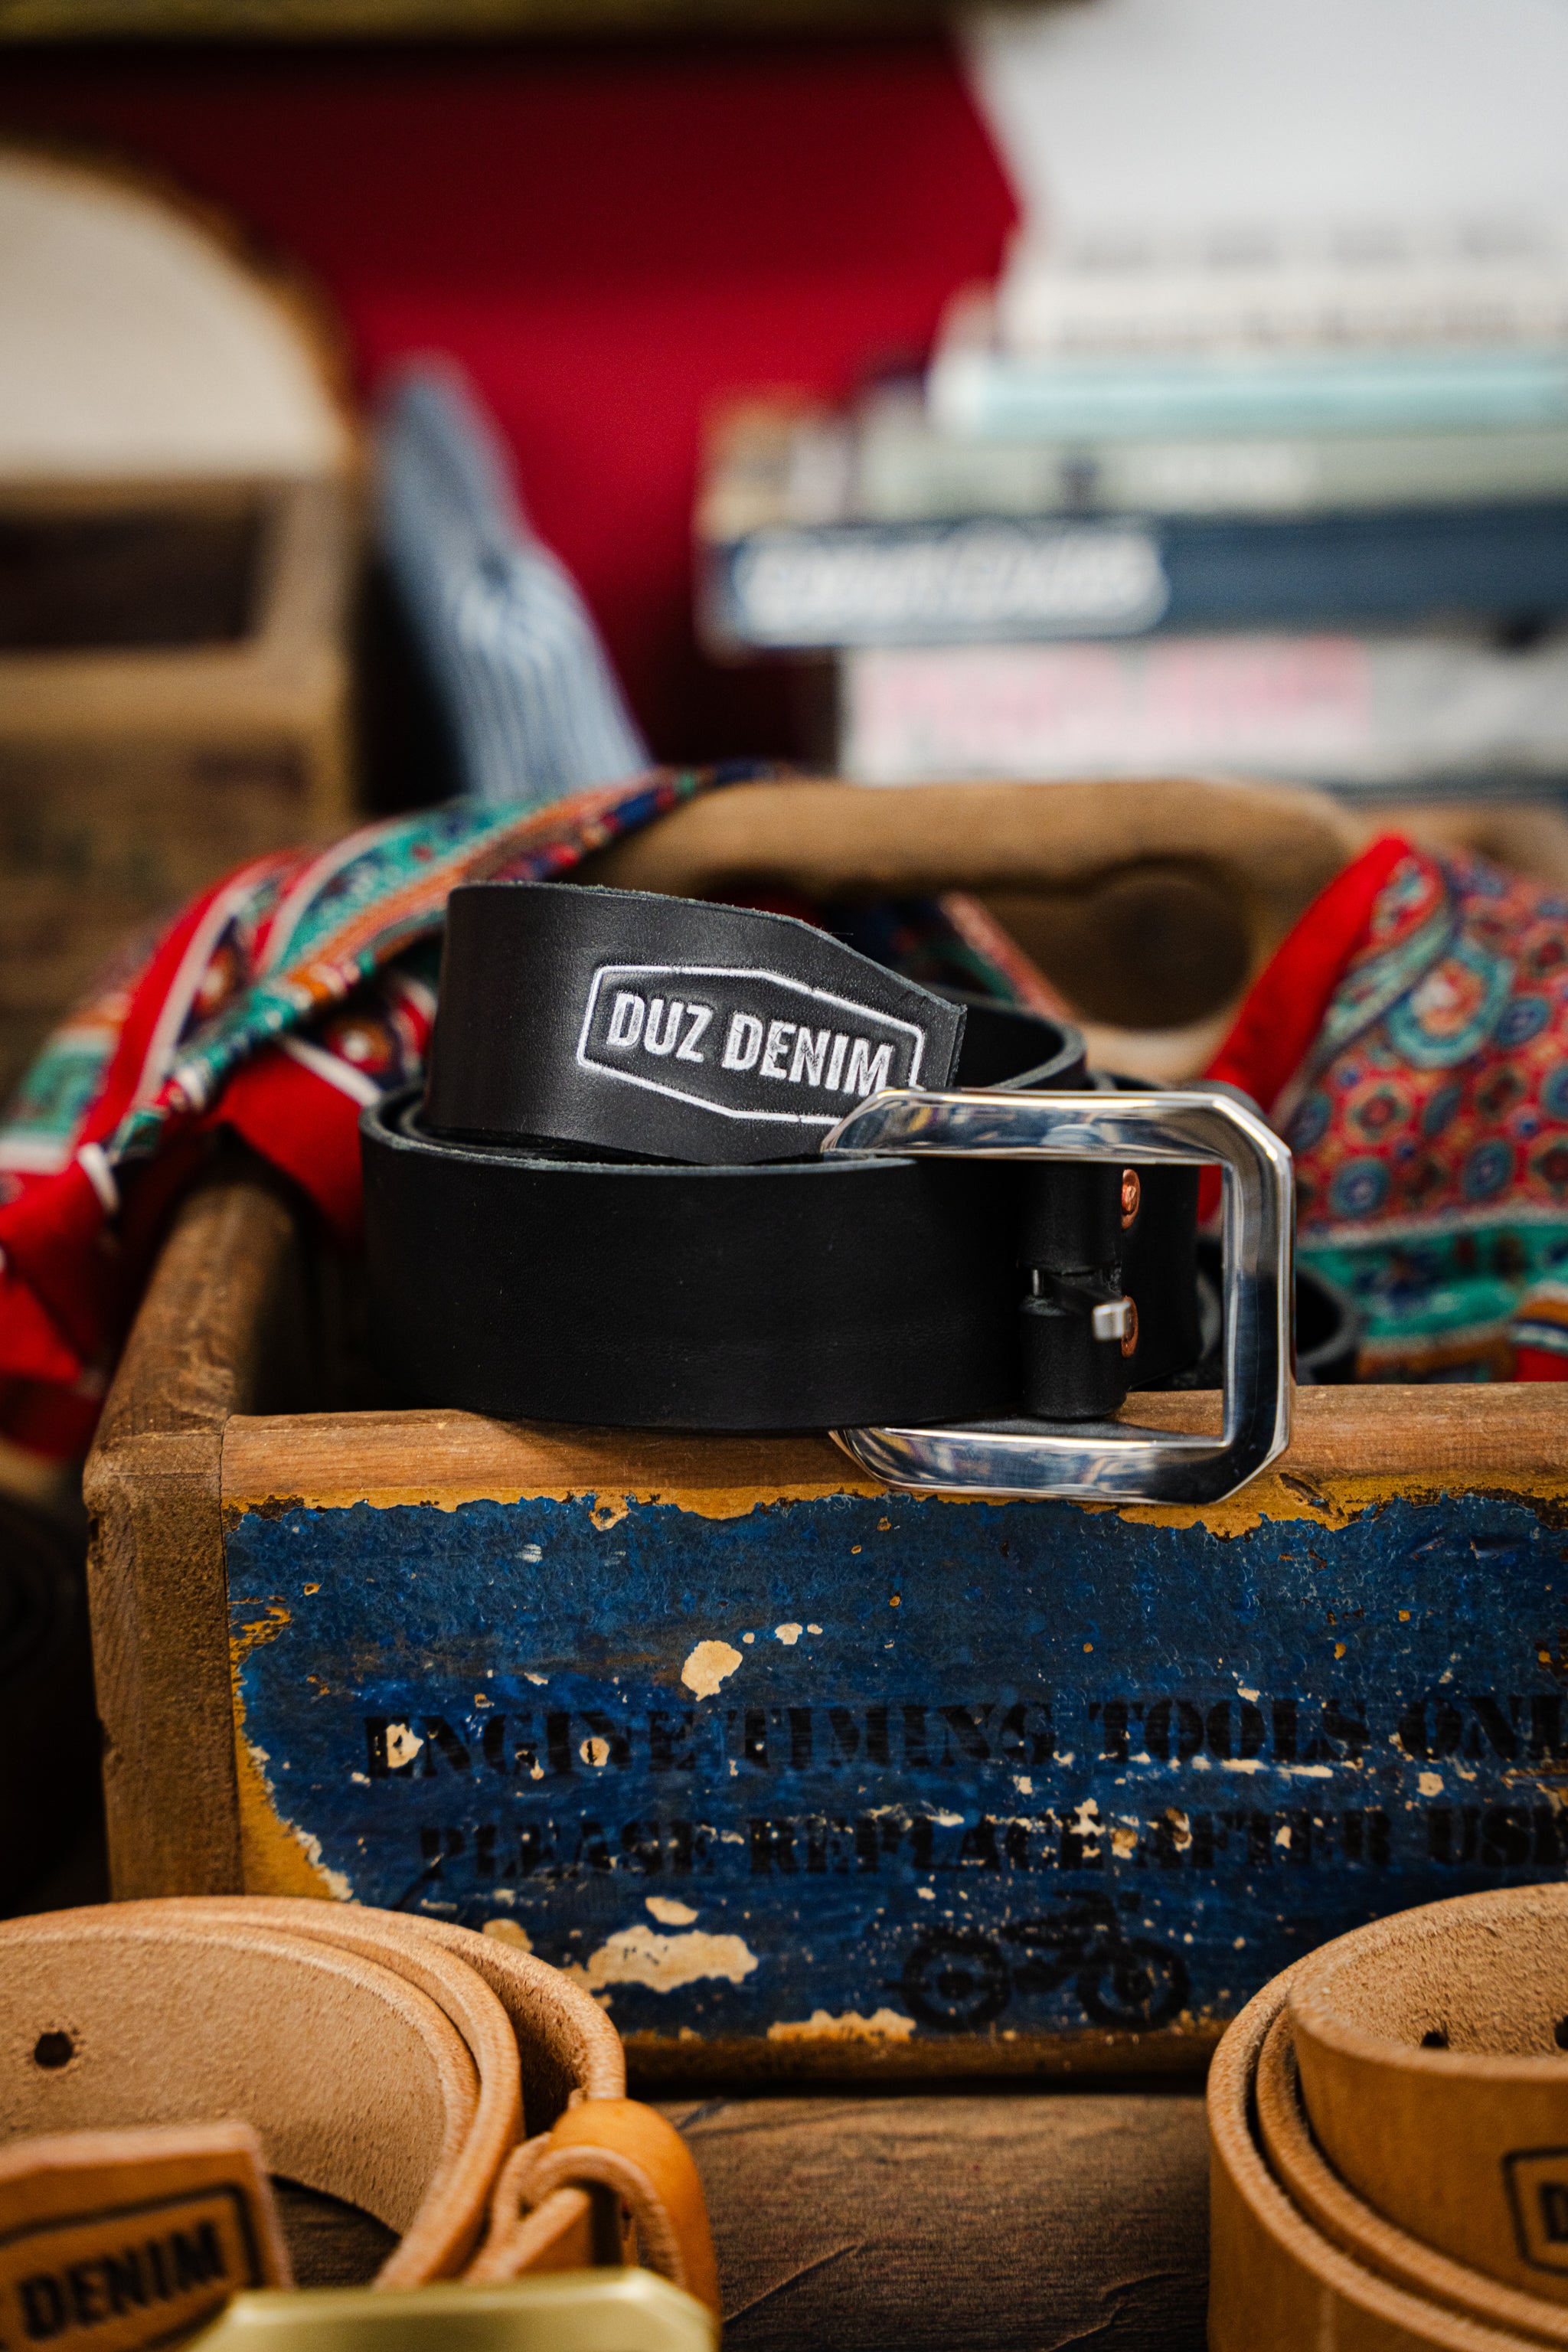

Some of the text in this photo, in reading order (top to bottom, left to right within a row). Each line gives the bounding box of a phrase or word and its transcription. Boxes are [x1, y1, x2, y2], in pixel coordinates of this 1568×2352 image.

[606, 990, 895, 1097] DUZ DENIM
[1087, 1697, 1370, 1764] TOOLS
[18, 2219, 227, 2341] DENIM
